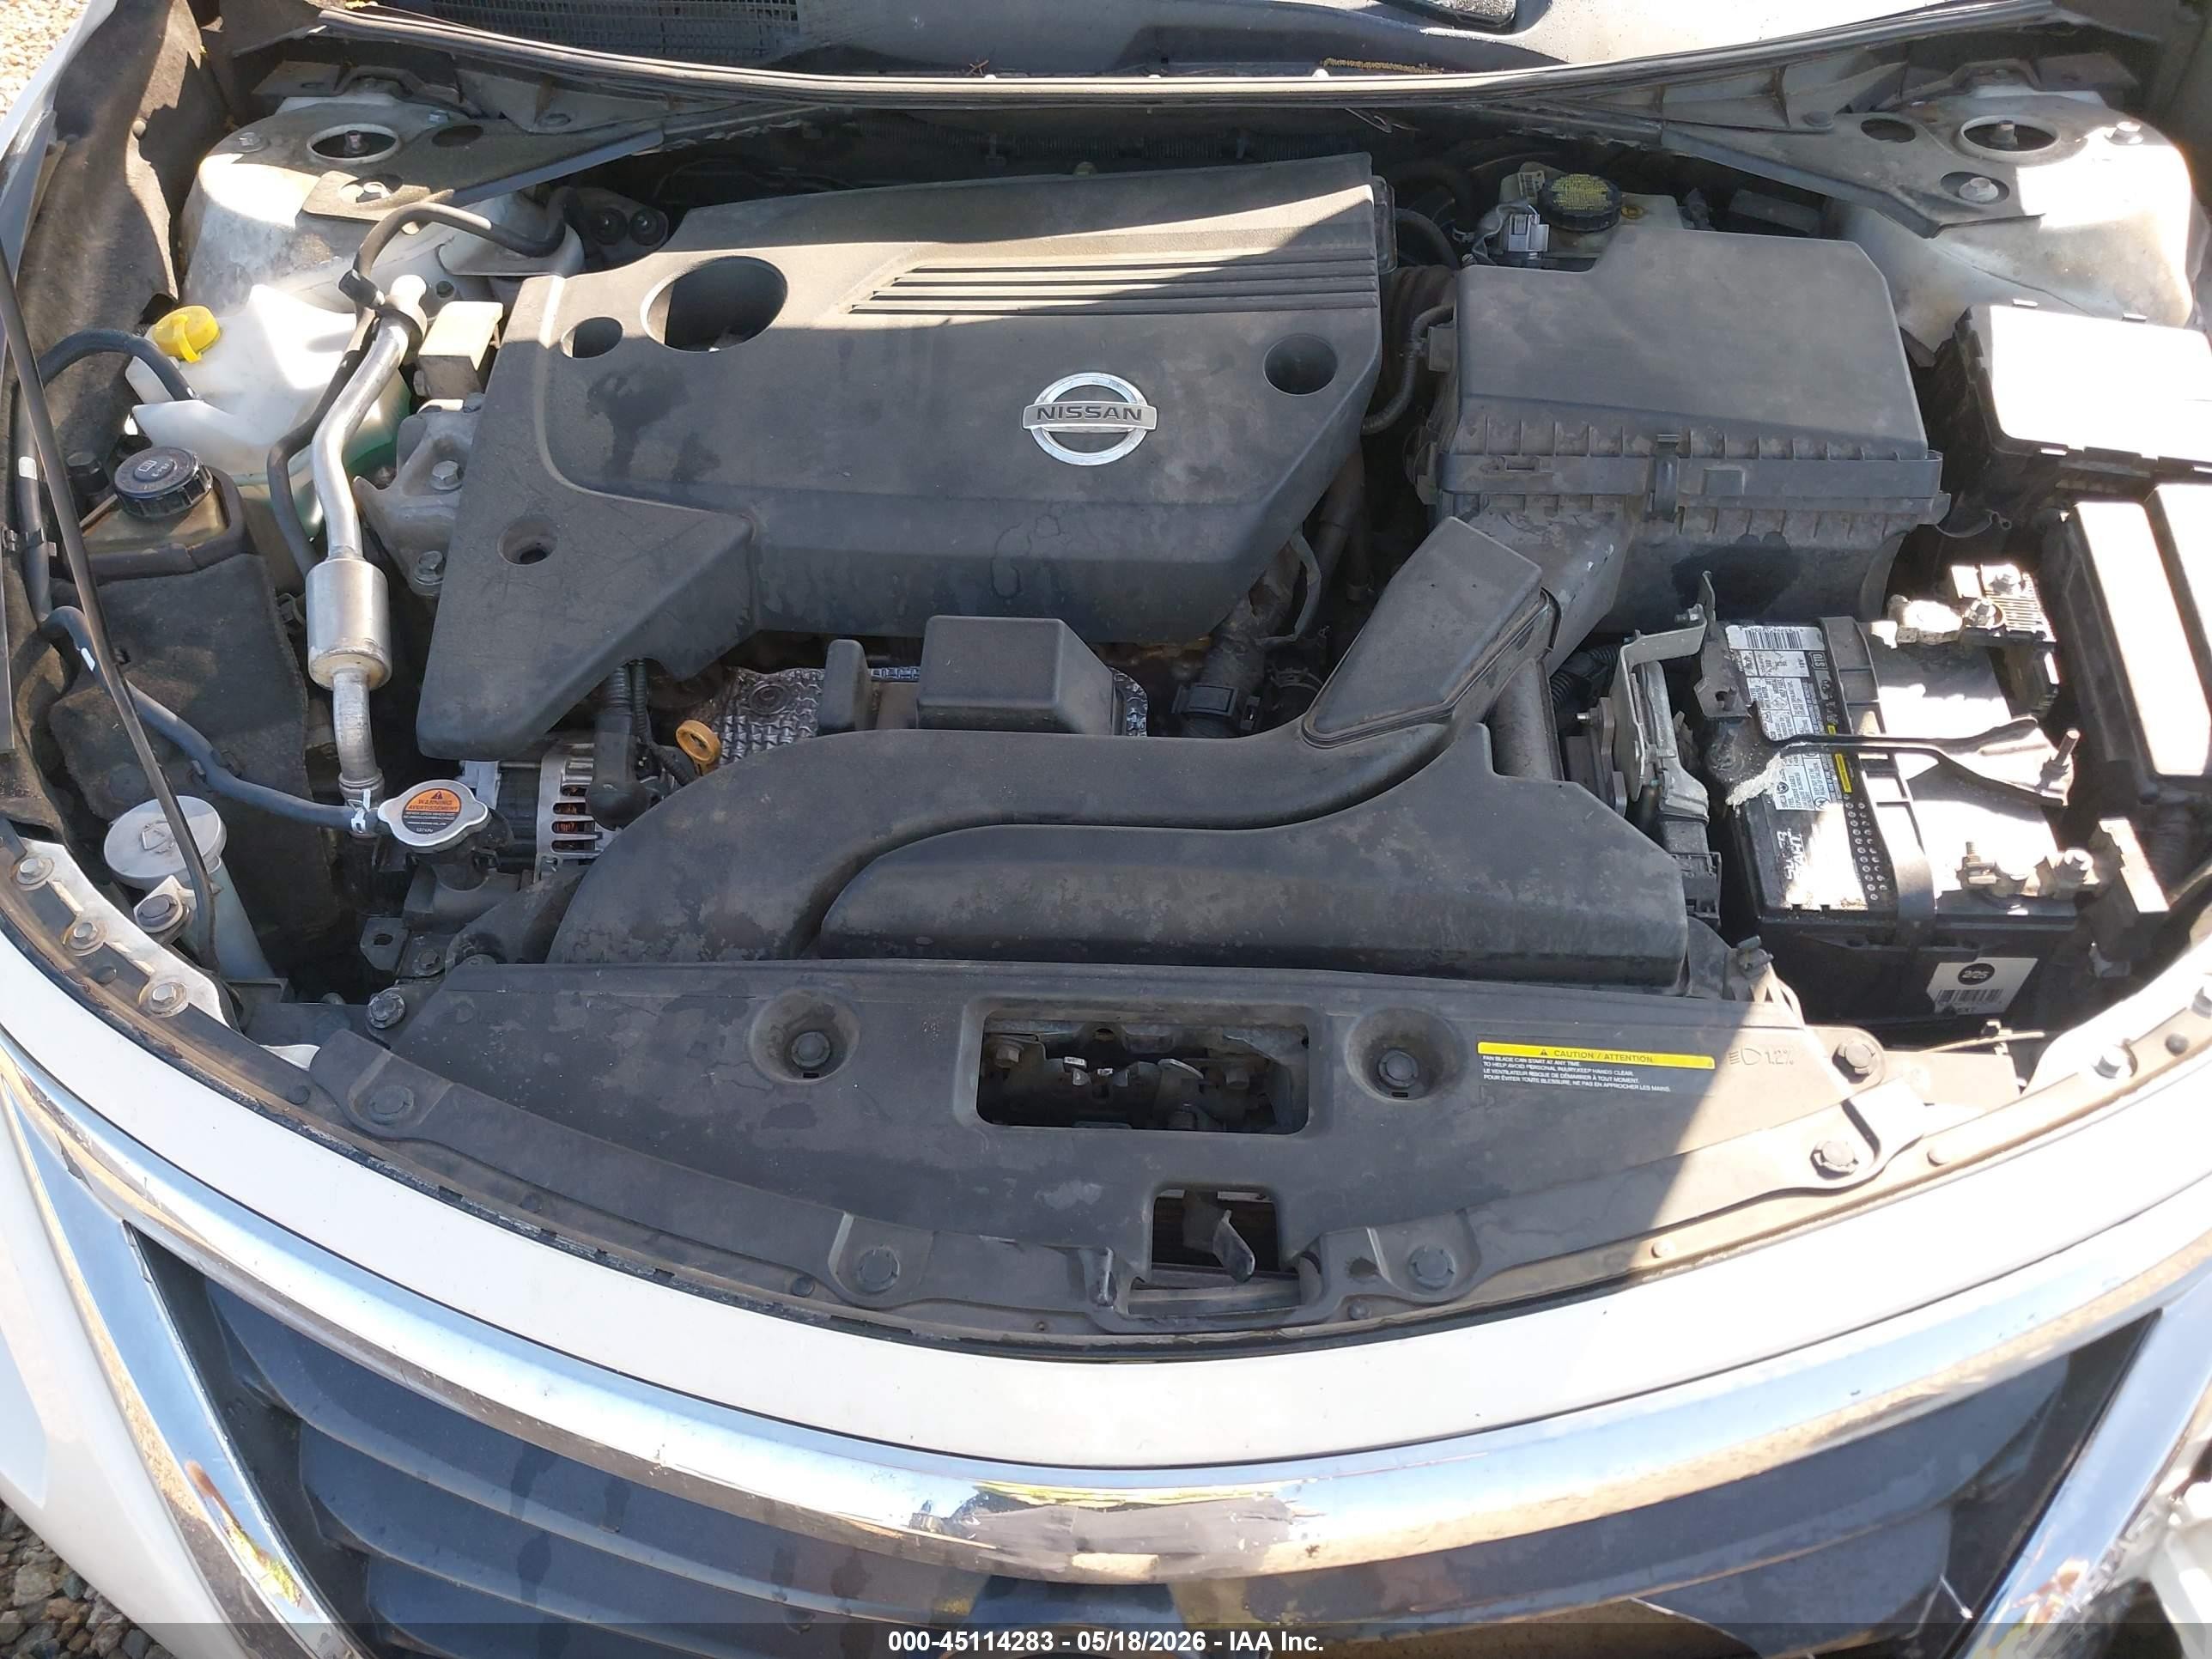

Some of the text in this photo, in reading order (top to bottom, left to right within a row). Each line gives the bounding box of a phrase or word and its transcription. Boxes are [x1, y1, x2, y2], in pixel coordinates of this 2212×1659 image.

[1036, 406, 1142, 421] NISSAN
[1554, 1050, 1594, 1059] CAUTION
[1604, 1053, 1653, 1063] ATTENTION
